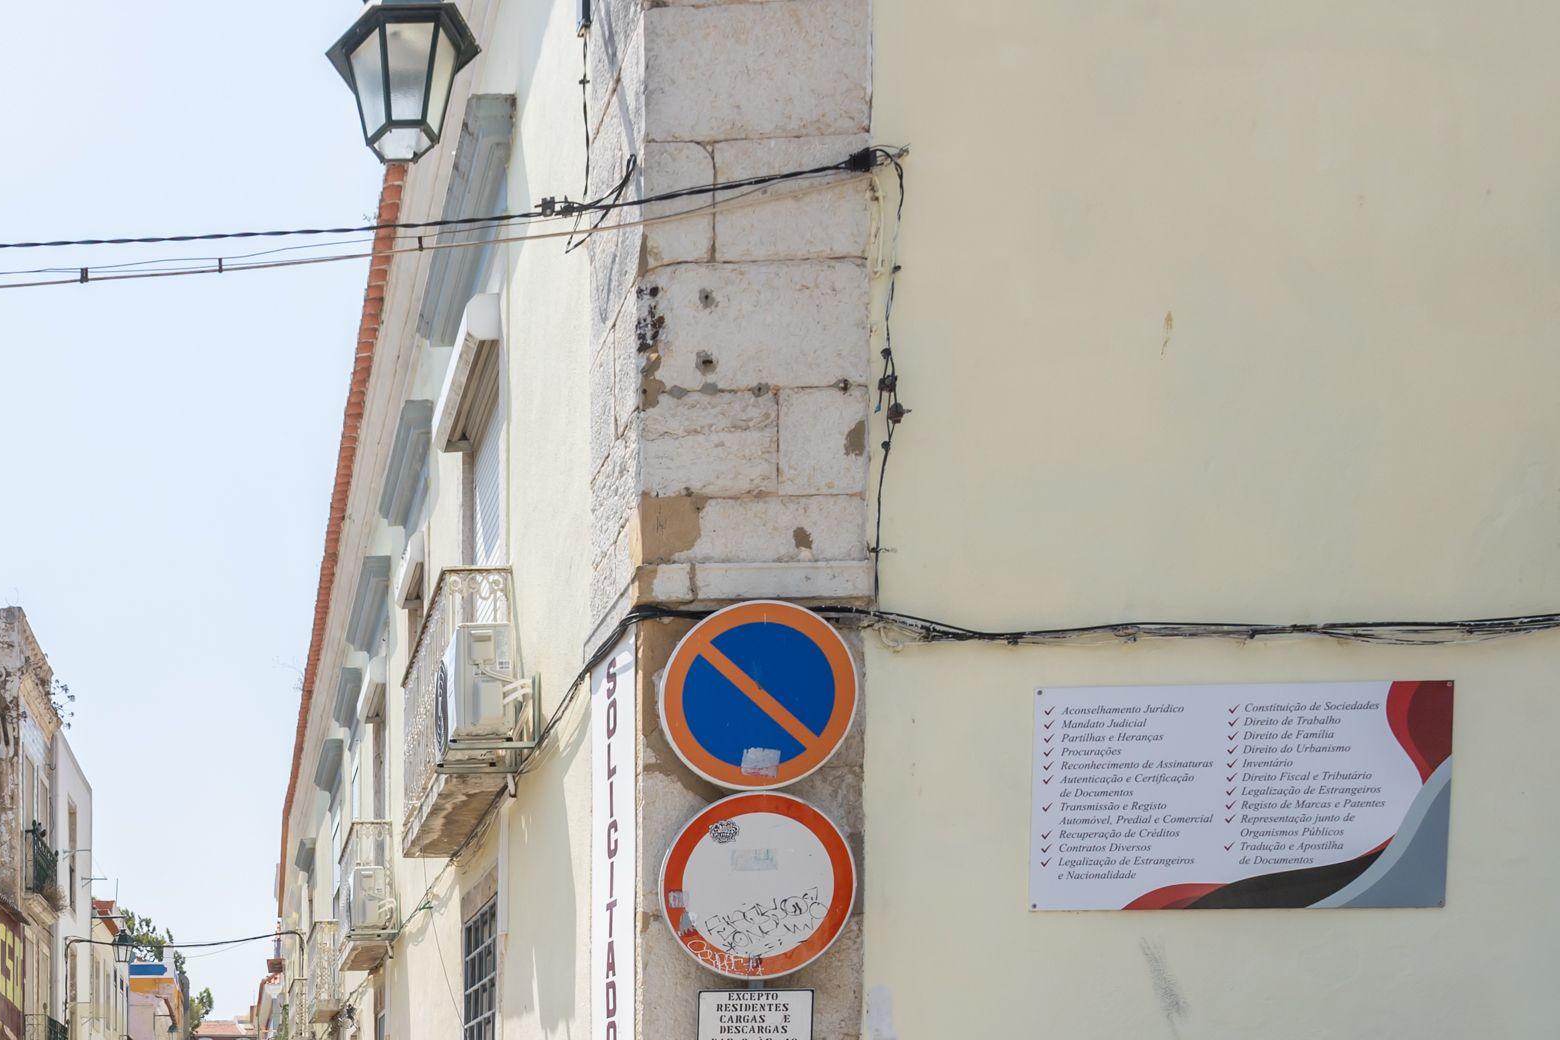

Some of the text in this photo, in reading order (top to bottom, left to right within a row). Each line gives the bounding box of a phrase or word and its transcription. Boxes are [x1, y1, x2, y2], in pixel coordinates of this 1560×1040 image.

[1061, 704, 1184, 715] Aconselhamento Jurídico
[1244, 701, 1380, 713] Constituição de Sociedades
[1061, 719, 1147, 729] Mandato Judicial
[1244, 715, 1341, 726] Direito de Trabalho
[1061, 733, 1105, 743] Partilhas
[1117, 733, 1164, 743] Heranças
[1243, 730, 1334, 740] Direito de Família
[1061, 747, 1121, 758] Procurações
[1243, 744, 1351, 754] Direito do Urbanismo
[1061, 760, 1214, 770] Reconhecimento de Assinaturas
[1242, 759, 1293, 768] Inventário
[1060, 775, 1123, 785] Autenticação
[1134, 774, 1195, 784] Certificação
[1242, 772, 1277, 782] Direito
[1279, 772, 1310, 781] Fiscal
[1322, 772, 1372, 781] Tributário
[1060, 788, 1133, 798] de Documentos
[1241, 785, 1381, 797] Legalização de Estrangeiros
[1060, 802, 1120, 811] Transmissão
[1131, 802, 1167, 812] Registo
[1241, 801, 1277, 811] Registo
[1280, 800, 1292, 809] de
[1295, 800, 1332, 809] Marcas
[1343, 799, 1385, 808] Patentes
[1116, 815, 1151, 824] Predial
[1163, 814, 1213, 823] Comercial
[1240, 813, 1355, 825] Representação junto de
[1059, 829, 1180, 840] Recuperação de Créditos
[1240, 827, 1344, 839] Organismos Públicos
[1059, 843, 1152, 853] Contratos Diversos
[1240, 842, 1286, 851] Tradução
[1297, 841, 1344, 852] Apostilha
[1058, 856, 1195, 867] Legalização de Estrangeiros
[1239, 856, 1314, 865] de Documentos
[1066, 871, 1136, 880] Nacionalidade
[728, 993, 778, 1001] EXCEPTO
[716, 1003, 789, 1012] RESIDENTES
[719, 1014, 790, 1023] CARGAS E
[720, 1025, 788, 1034] DESCARGAS
